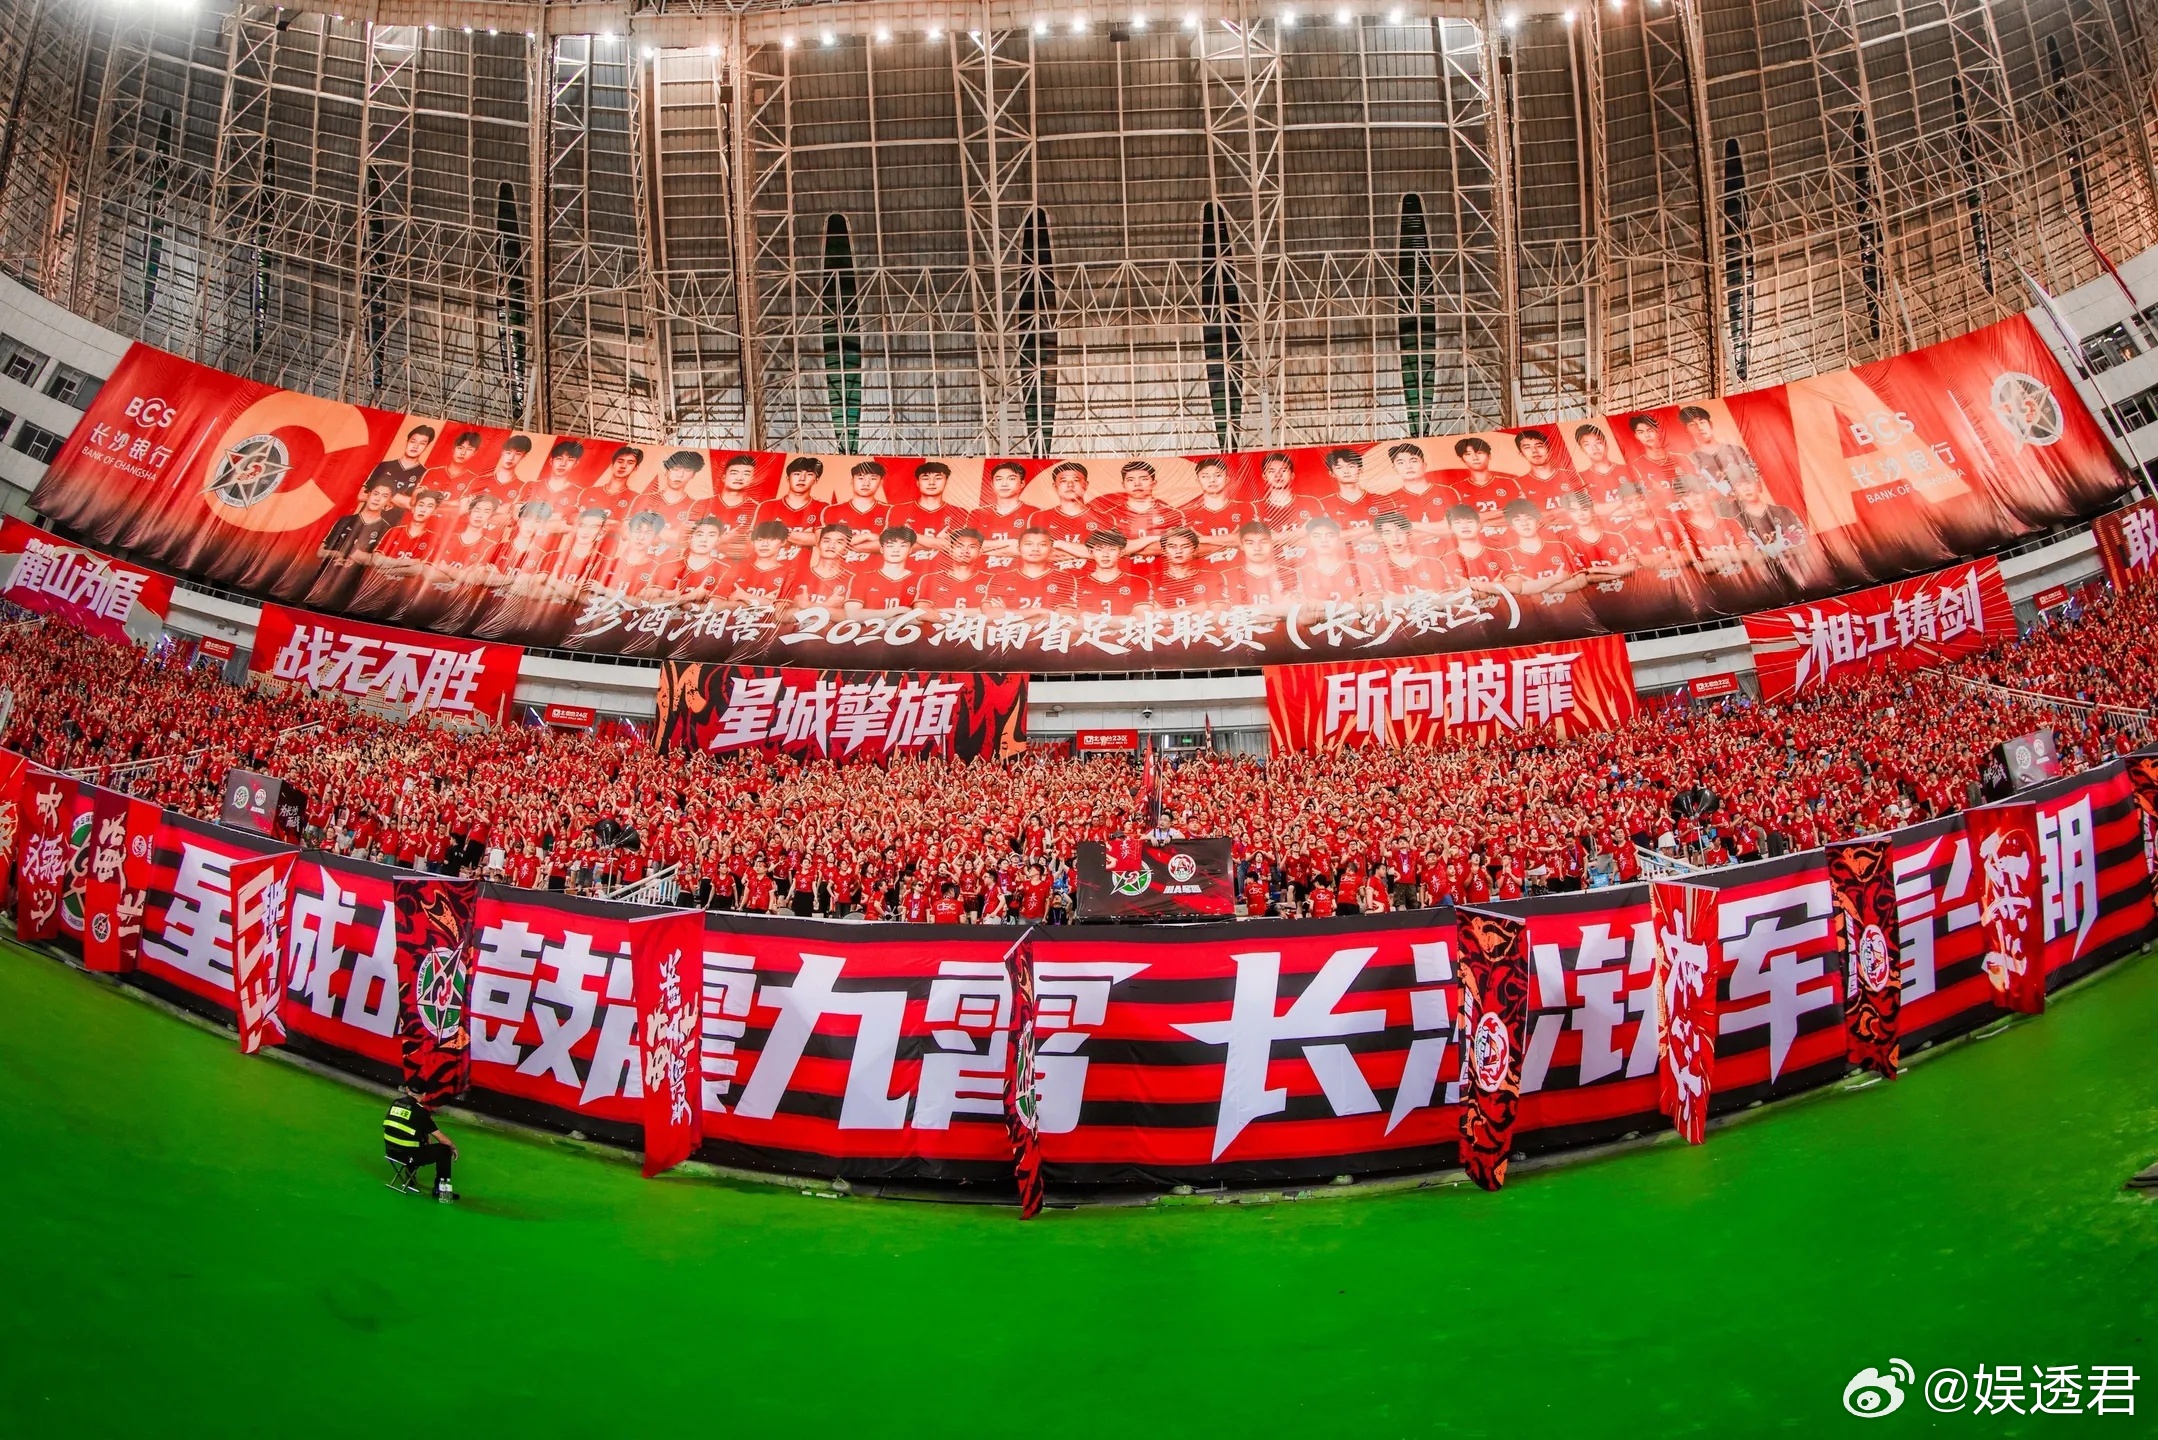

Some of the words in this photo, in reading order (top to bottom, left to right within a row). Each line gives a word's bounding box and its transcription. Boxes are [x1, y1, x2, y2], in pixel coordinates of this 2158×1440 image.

[125, 397, 176, 428] BCS
[1850, 411, 1915, 446] BCS
[81, 446, 104, 462] BANK
[103, 455, 115, 465] OF
[114, 458, 157, 482] CHANGSHA
[90, 422, 173, 469] 长沙银行
[1852, 441, 1956, 489] 长沙银行
[1866, 488, 1896, 504] BANK
[1897, 484, 1911, 495] OF
[3, 538, 150, 623] 麓山为盾
[1785, 566, 1985, 694] 湘江铸剑
[272, 624, 486, 718] 战无不胜
[708, 676, 966, 758] 星城擎旗
[1324, 651, 1584, 746] 所向披靡
